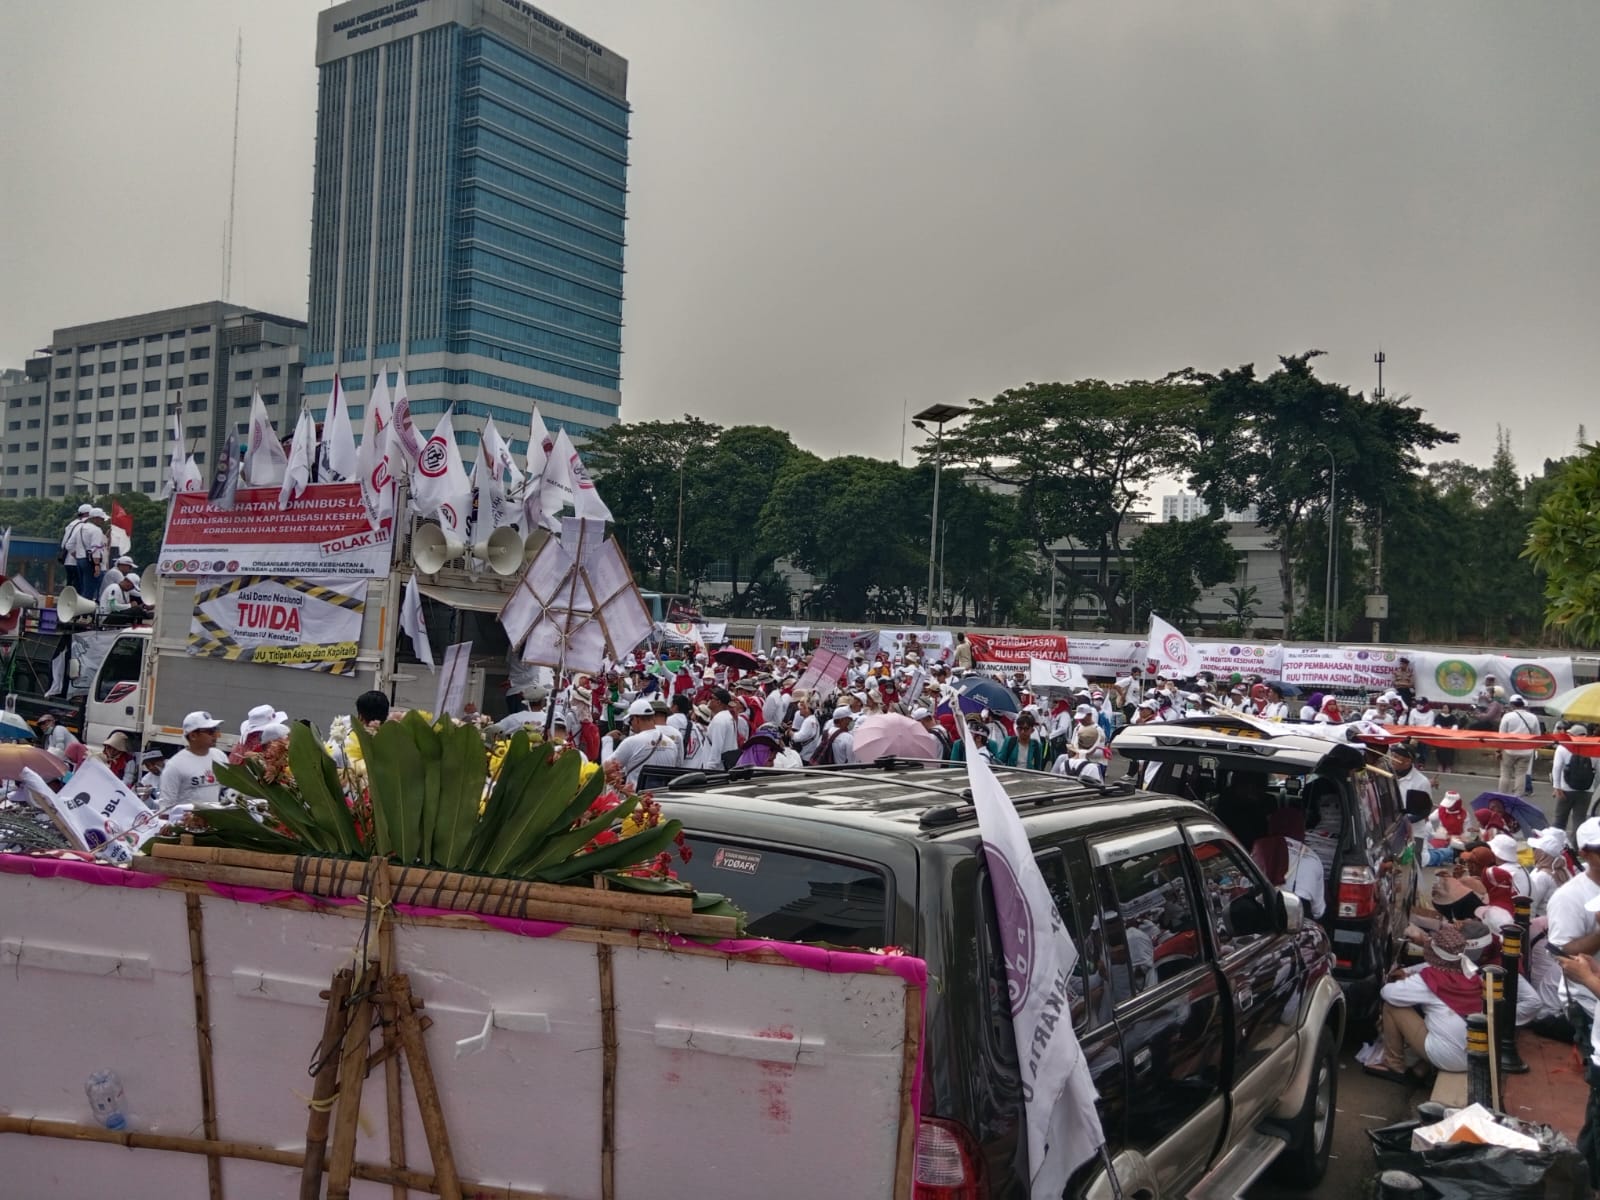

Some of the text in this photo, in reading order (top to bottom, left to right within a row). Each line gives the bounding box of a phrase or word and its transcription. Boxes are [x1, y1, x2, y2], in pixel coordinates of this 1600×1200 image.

[346, 8, 418, 40] REPUBLIK INDONESIA
[180, 505, 204, 514] RUU
[205, 501, 277, 514] KEHATAN
[349, 498, 366, 508] LA
[172, 516, 233, 526] LIBERALISASI
[255, 513, 323, 523] KAPITALISASI
[325, 512, 368, 521] KESEHA
[309, 524, 346, 532] RAKYAT
[322, 534, 372, 554] TOLAK
[238, 591, 252, 600] Aksi
[273, 593, 303, 604] Nasional
[237, 603, 300, 633] TUNDA
[995, 638, 1057, 648] PEMBAHASAN
[269, 650, 291, 660] Titipan
[293, 649, 311, 660] Asing
[312, 649, 326, 657] dan
[328, 646, 356, 657] Kapitalis
[995, 650, 1067, 660] RUU KESEHATAN
[1304, 662, 1352, 671] PEMBAHASAN
[1354, 664, 1370, 673] RUU
[1286, 673, 1300, 681] RUU
[1302, 673, 1329, 681] TITIPAN
[1330, 674, 1352, 682] ASING
[1371, 677, 1395, 686] KAPITA
